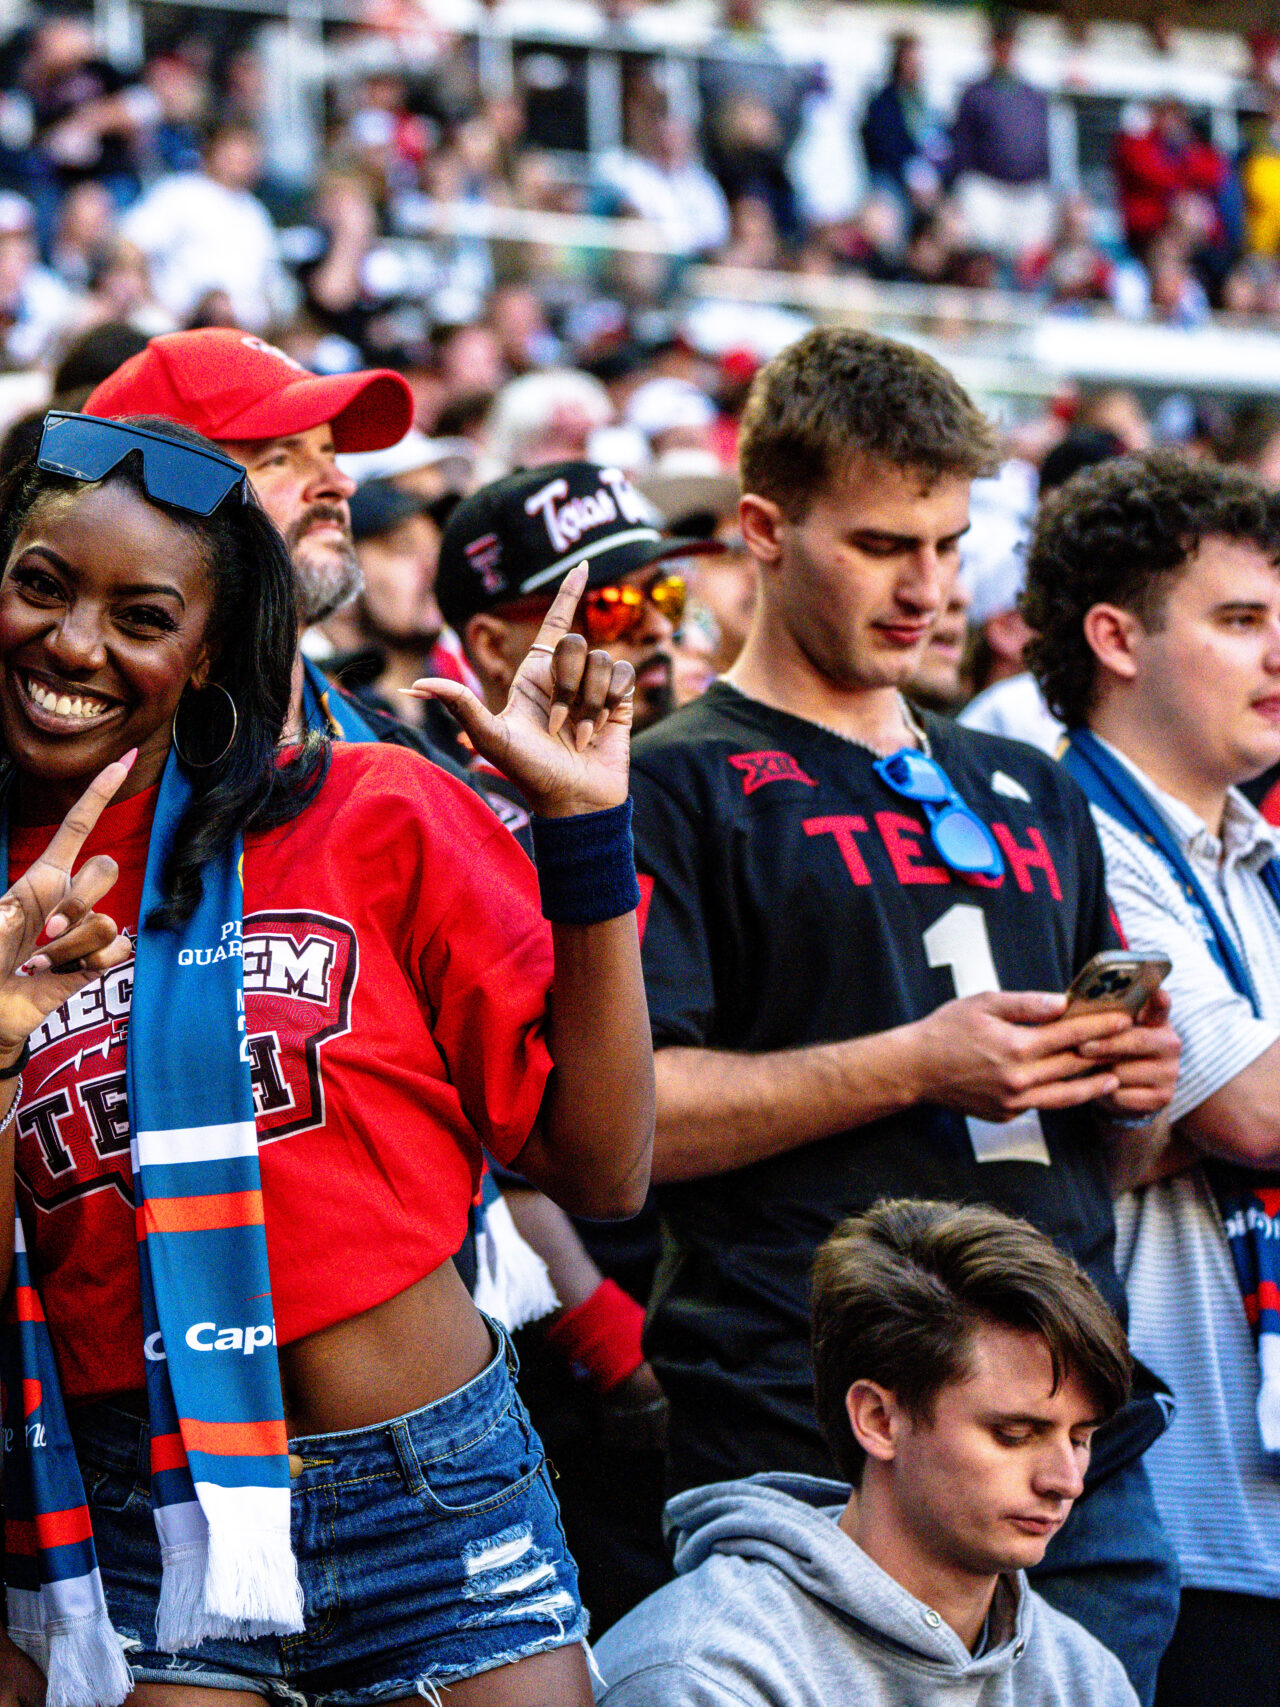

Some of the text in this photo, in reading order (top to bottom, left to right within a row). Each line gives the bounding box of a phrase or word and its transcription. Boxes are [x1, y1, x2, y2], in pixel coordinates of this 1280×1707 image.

[802, 811, 1062, 902] TEH
[16, 1031, 296, 1179] TEH
[923, 903, 1051, 1166] 1
